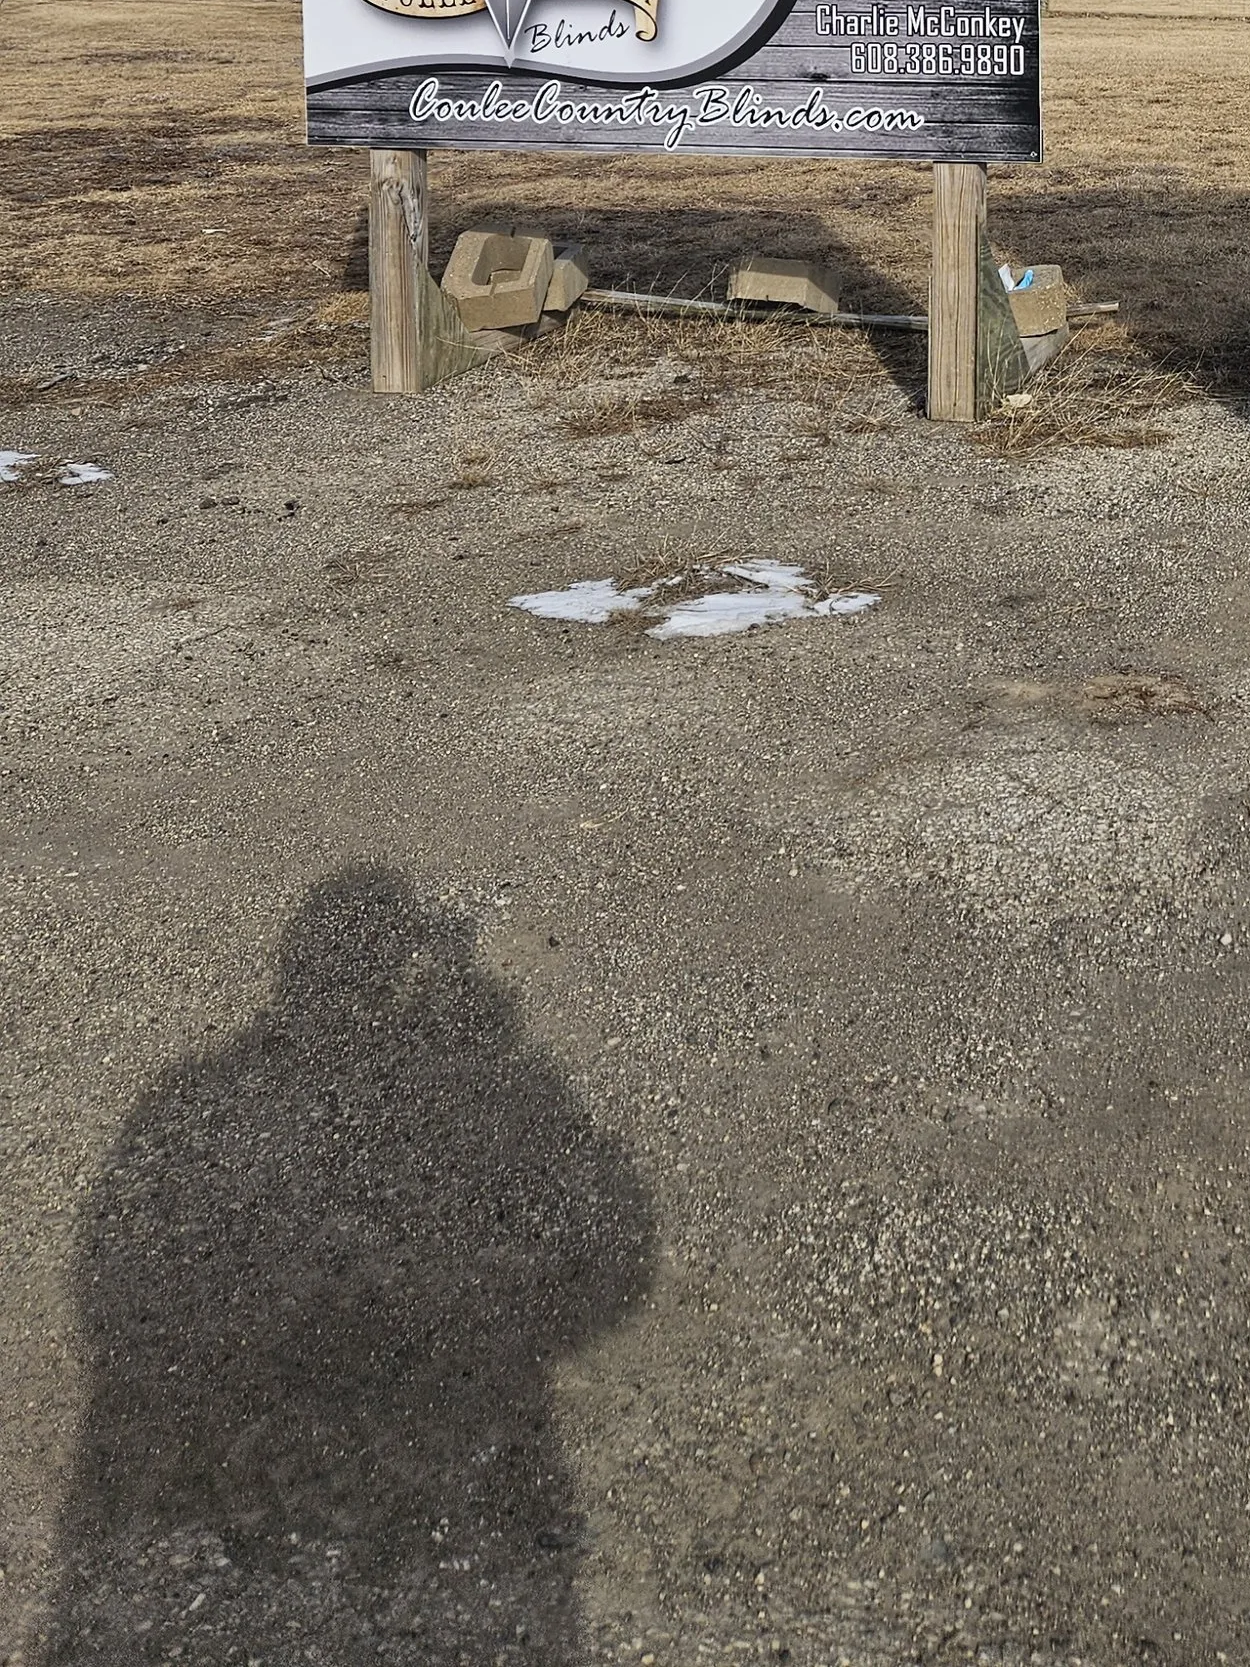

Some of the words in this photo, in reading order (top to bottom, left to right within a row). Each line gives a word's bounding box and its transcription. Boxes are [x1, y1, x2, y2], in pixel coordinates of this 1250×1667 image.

[524, 9, 630, 54] Blinds
[816, 4, 899, 37] Charlie
[906, 5, 1026, 44] McConkey
[850, 43, 1025, 76] 608.386.9890
[408, 77, 925, 150] CouleeCountryBlinds.com
